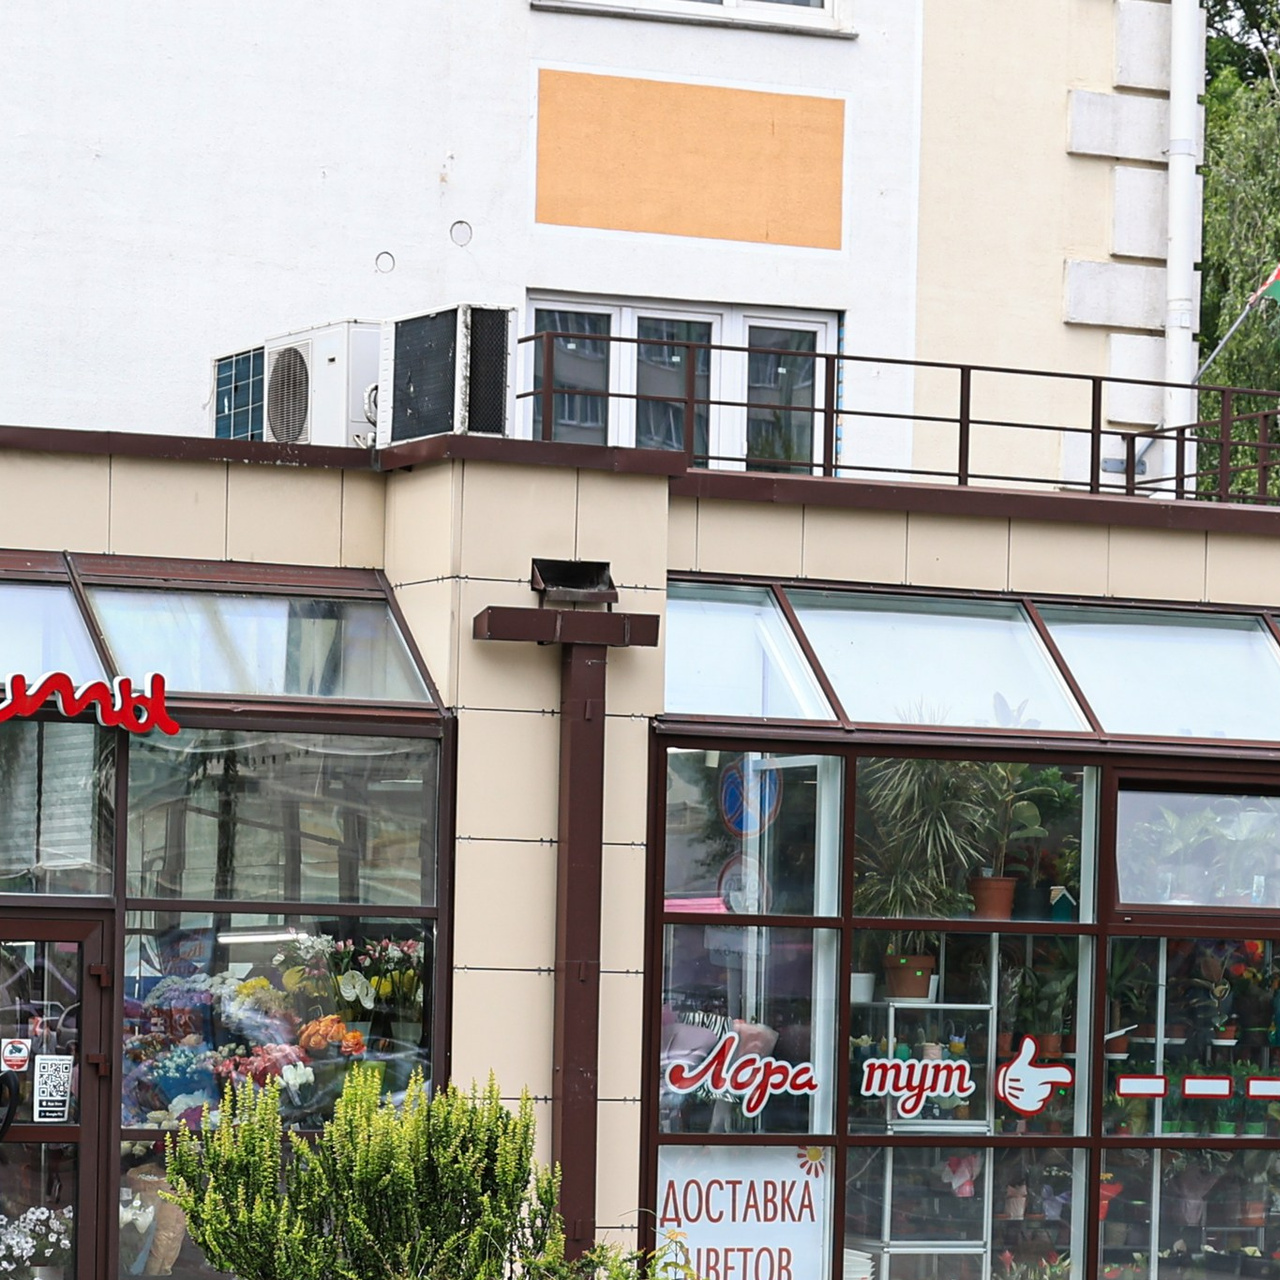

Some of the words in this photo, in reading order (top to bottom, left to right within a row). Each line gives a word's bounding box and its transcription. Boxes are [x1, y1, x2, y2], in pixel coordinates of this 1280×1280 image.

[665, 1031, 819, 1118] Лора
[861, 1058, 975, 1118] тут
[660, 1179, 815, 1228] ДОСТАВКА
